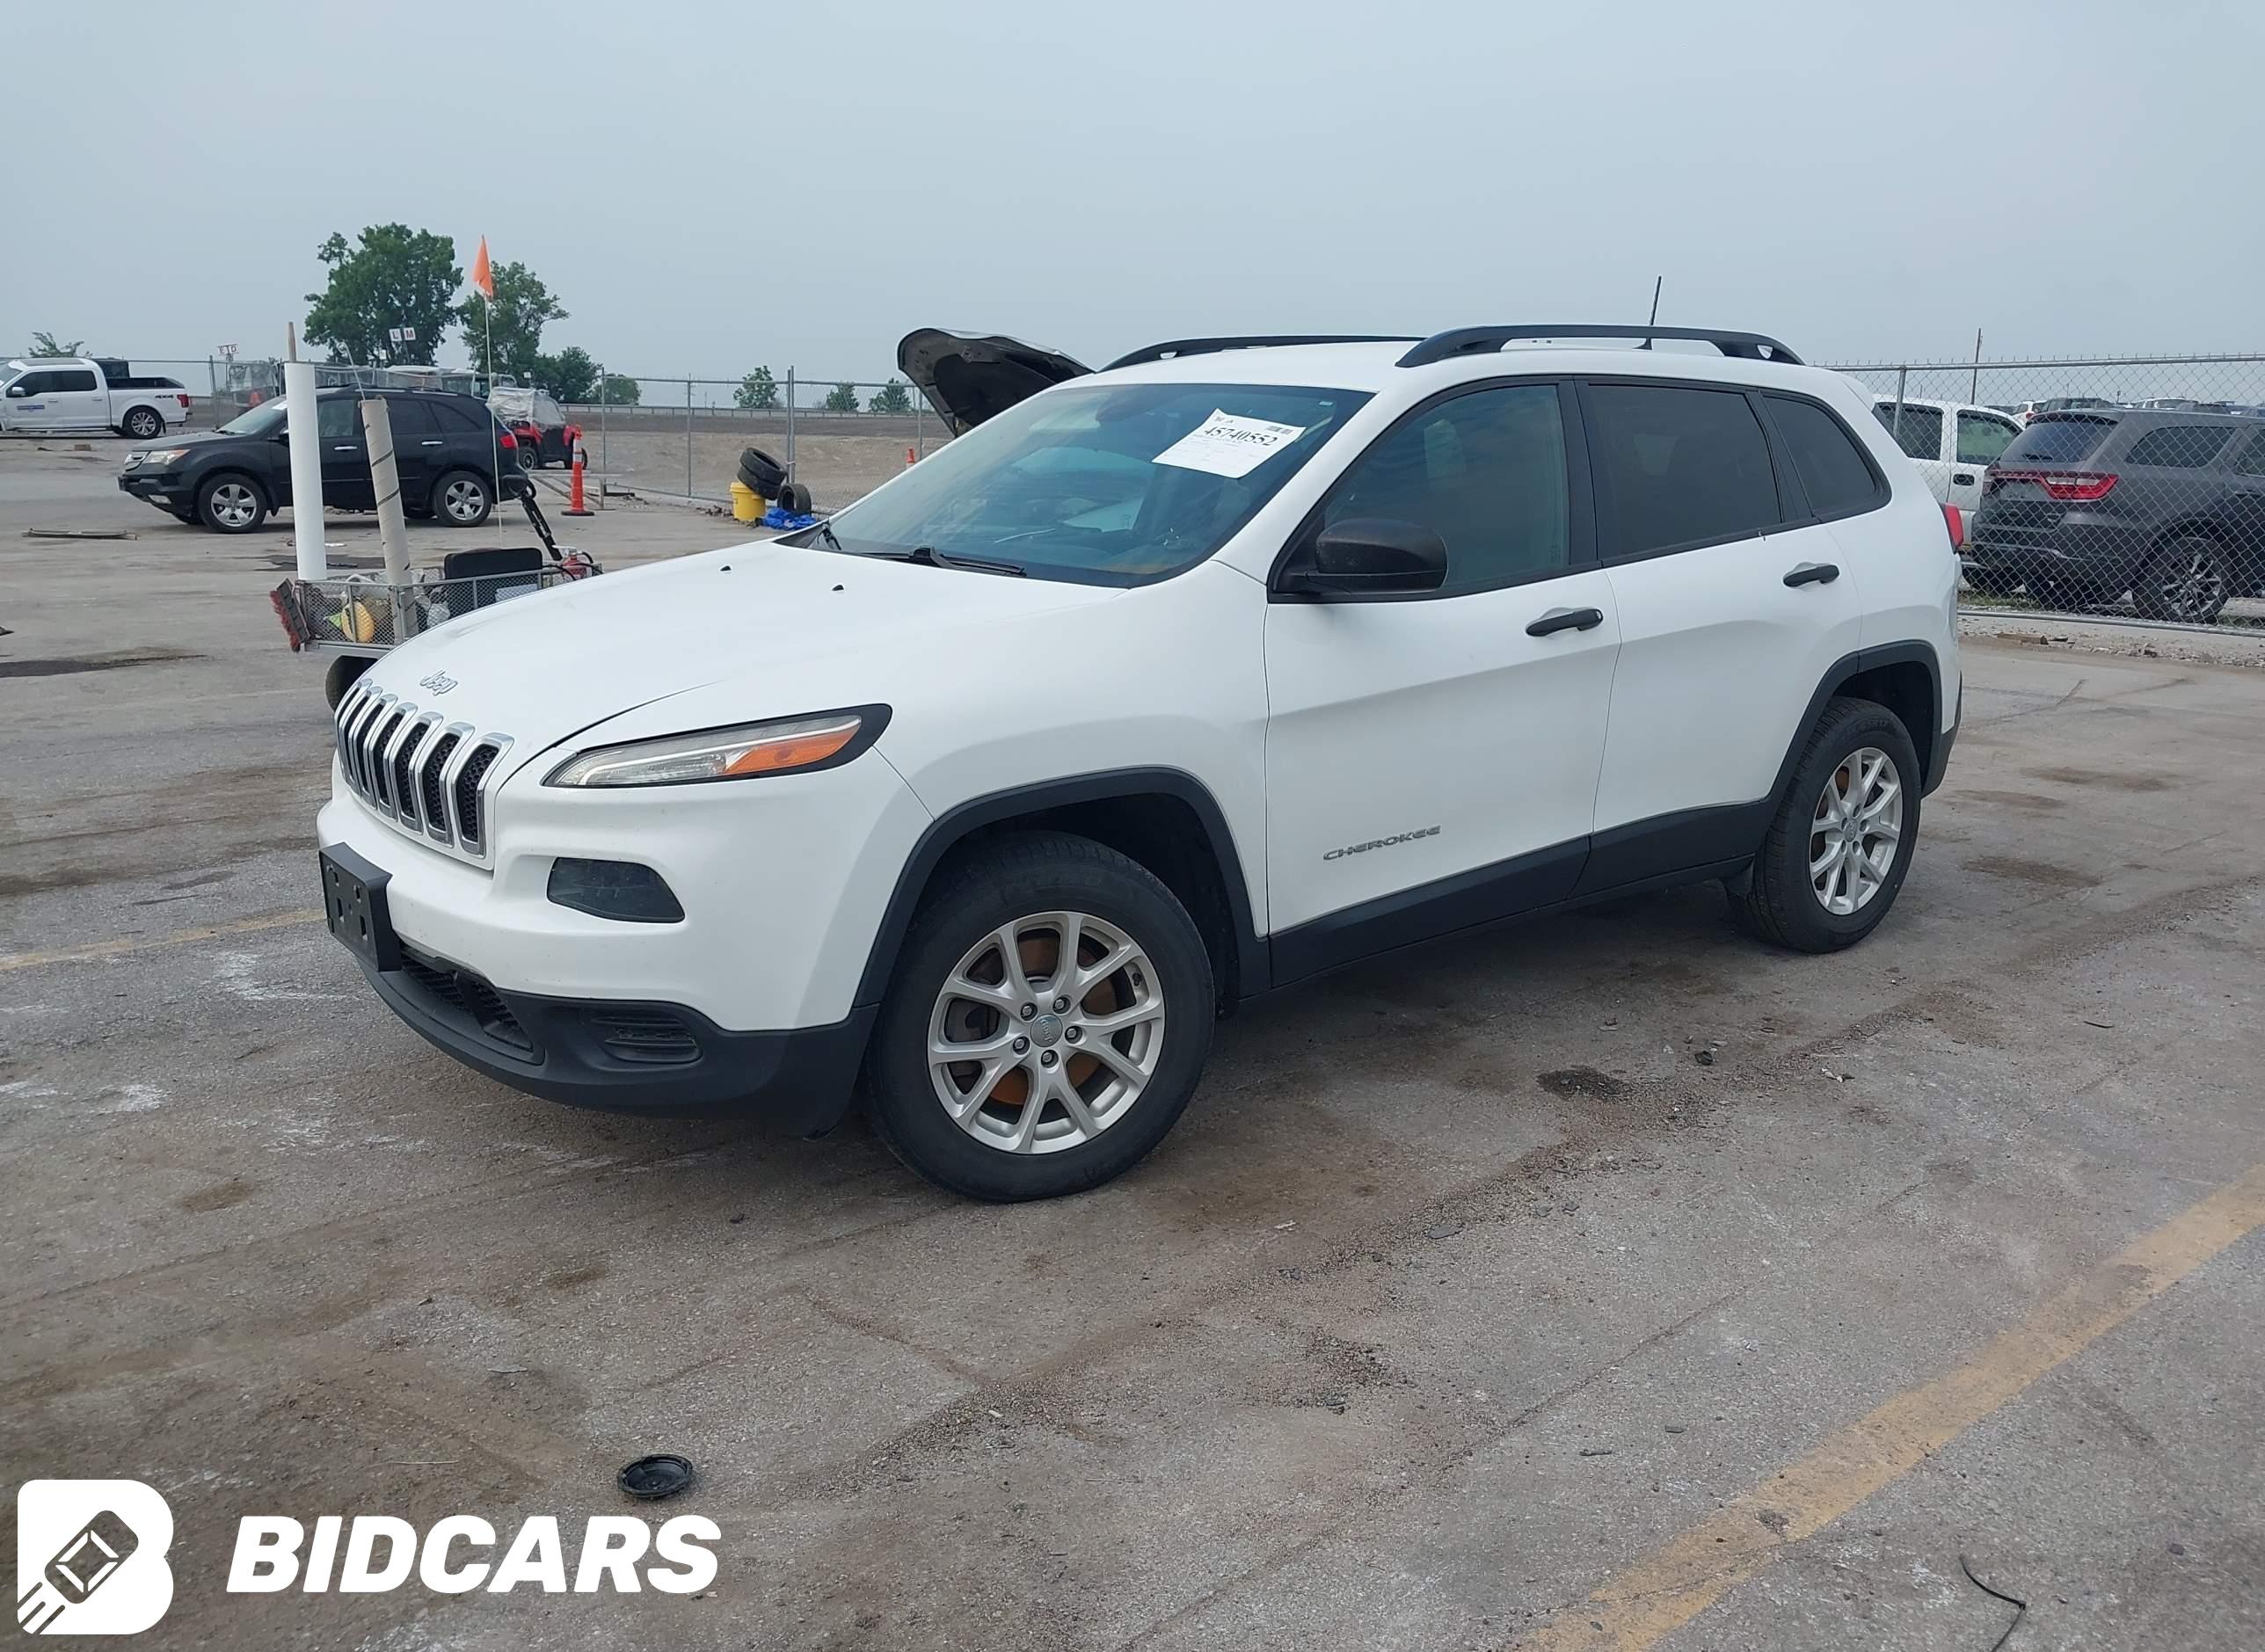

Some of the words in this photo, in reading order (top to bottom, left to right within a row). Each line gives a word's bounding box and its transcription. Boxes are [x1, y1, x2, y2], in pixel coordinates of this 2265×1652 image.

[1204, 426, 1278, 447] 45740552
[419, 669, 458, 696] Jeep
[1322, 825, 1442, 861] CHEROKEE
